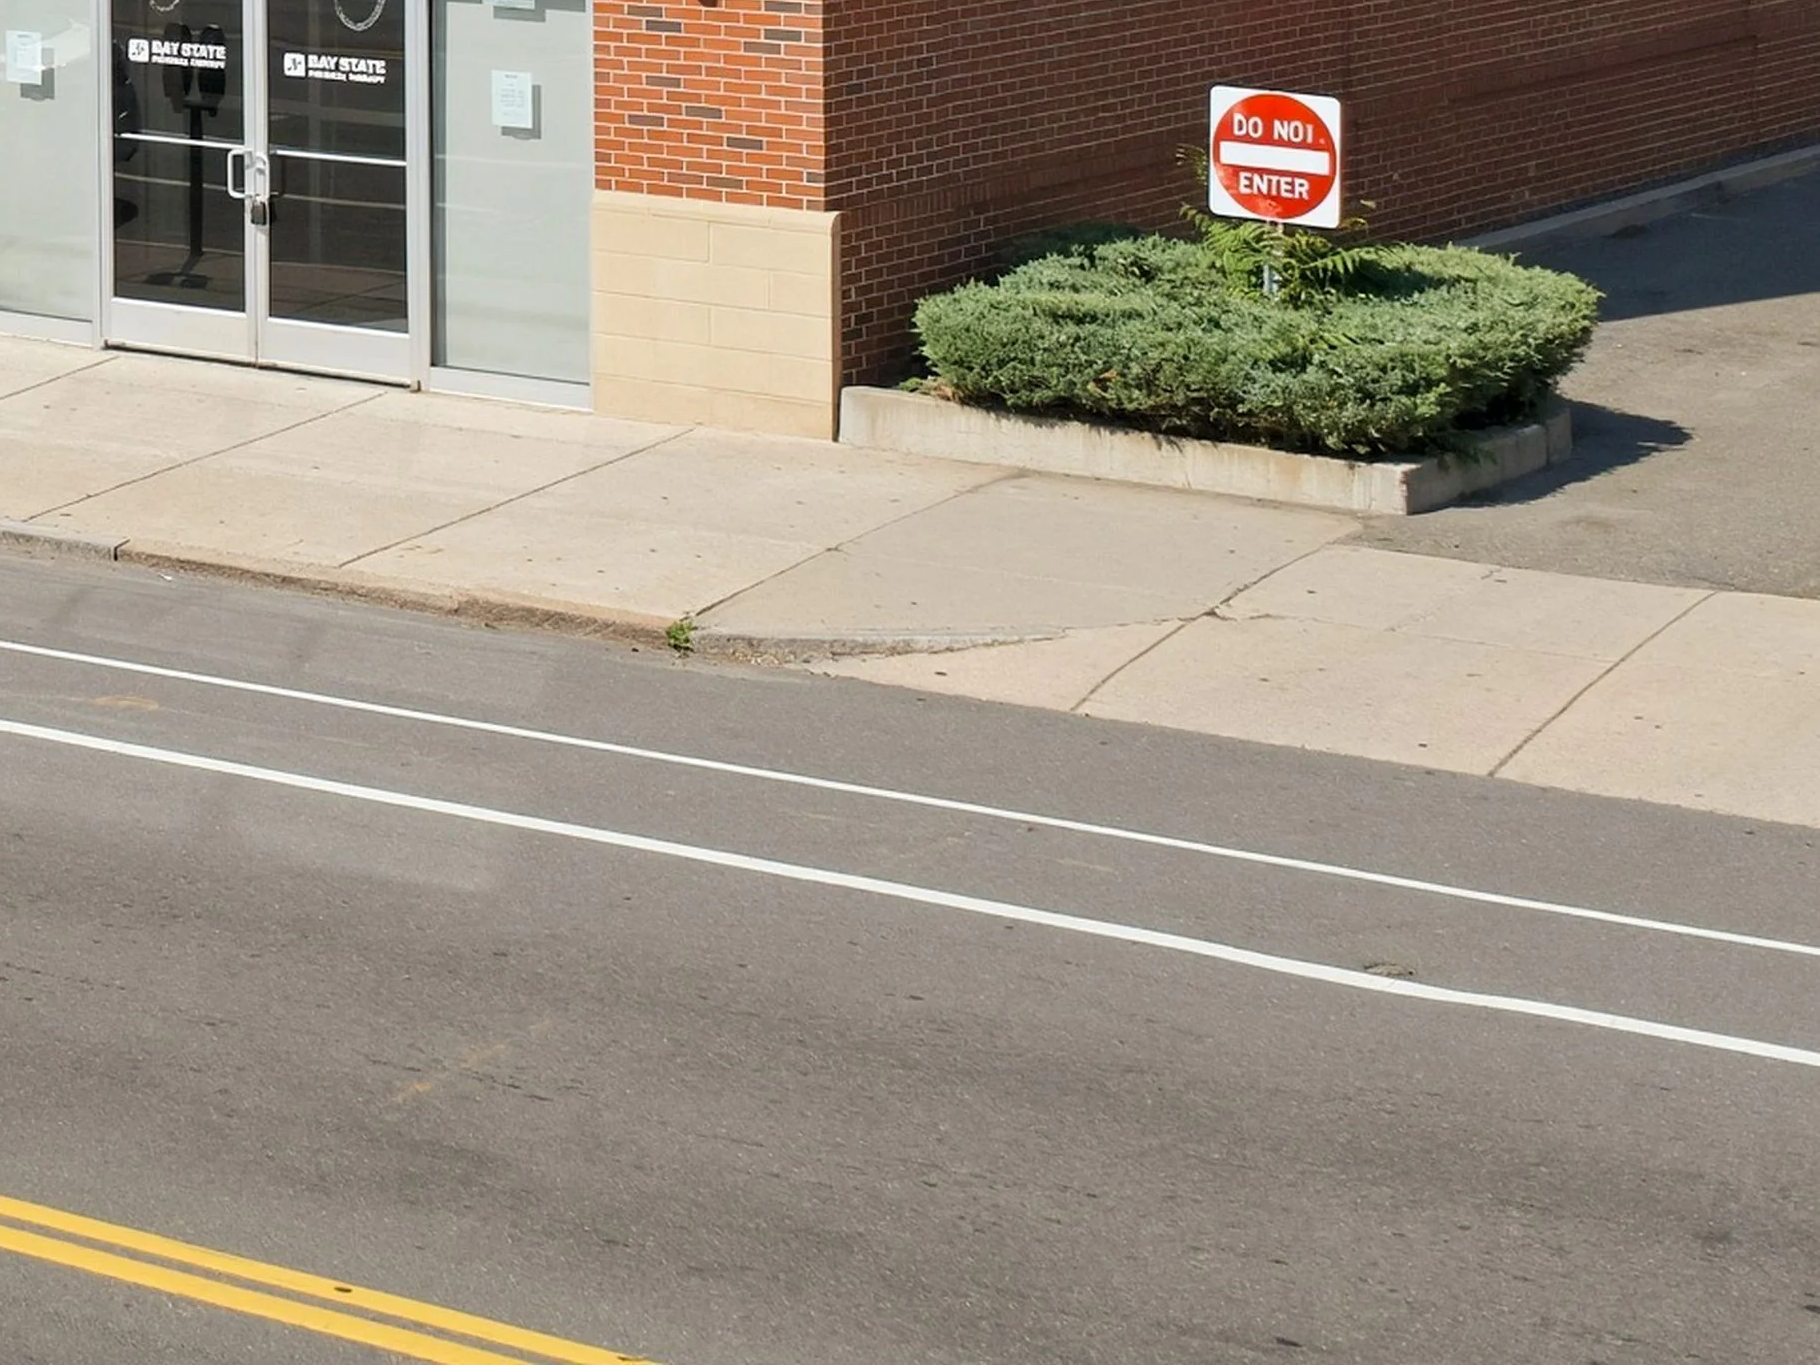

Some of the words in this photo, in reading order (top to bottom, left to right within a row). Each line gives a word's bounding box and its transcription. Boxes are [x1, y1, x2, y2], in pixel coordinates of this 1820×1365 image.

[181, 43, 227, 59] STATE
[308, 54, 338, 70] BAY
[339, 57, 386, 74] STATE
[1233, 112, 1264, 138] DO
[1239, 171, 1310, 201] ENTER
